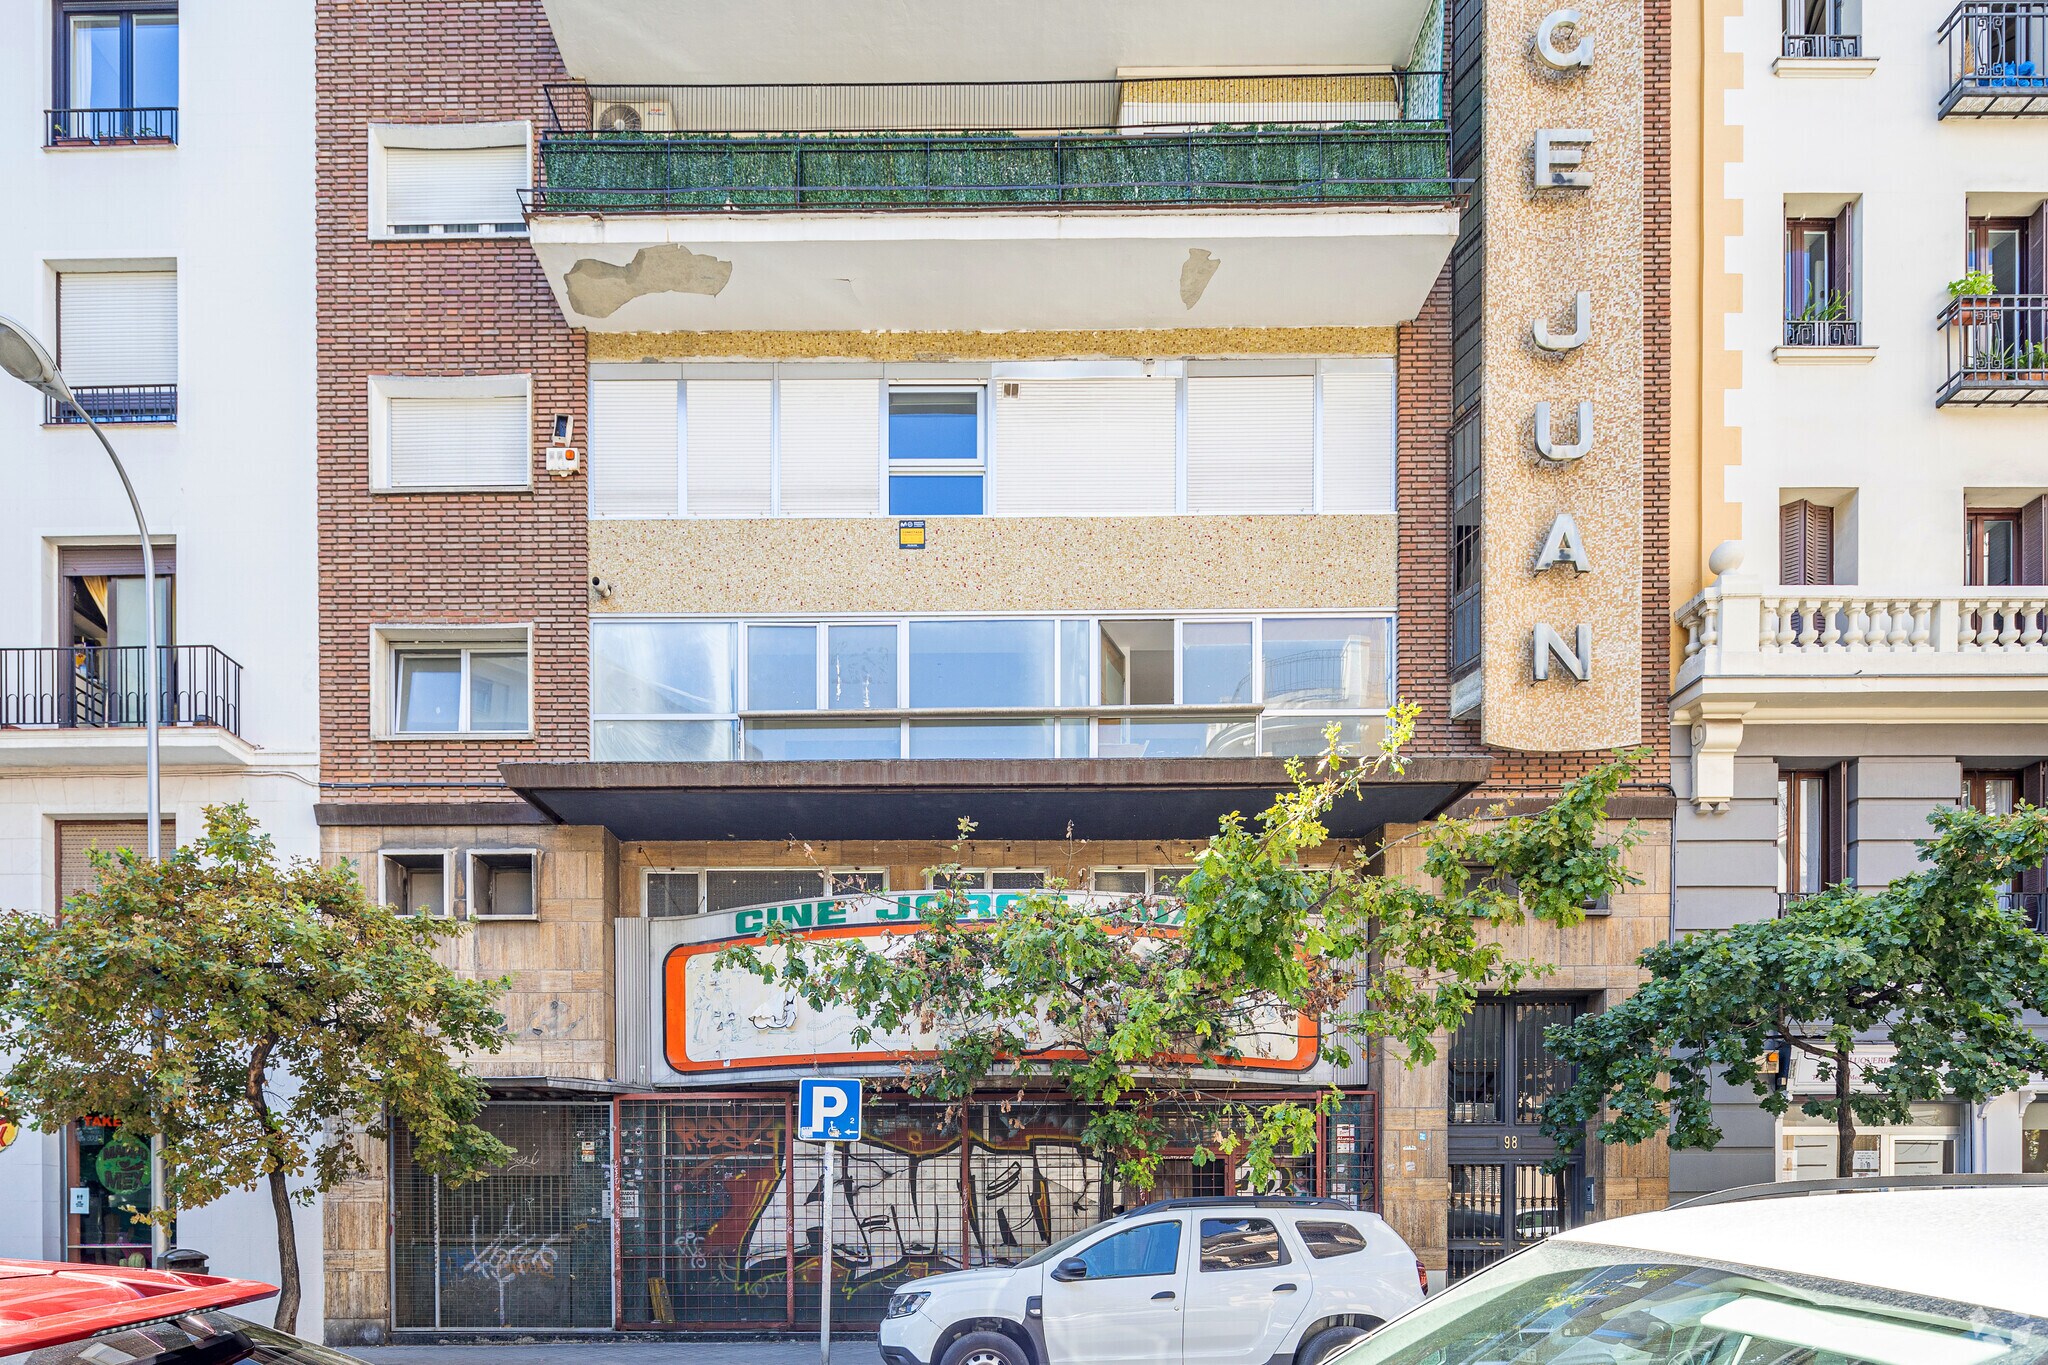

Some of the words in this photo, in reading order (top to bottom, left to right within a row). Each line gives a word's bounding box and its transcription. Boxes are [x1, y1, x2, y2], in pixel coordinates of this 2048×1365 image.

[1531, 290, 1594, 682] JUAN
[735, 901, 847, 934] CINE
[812, 1086, 848, 1132] P
[84, 1116, 122, 1127] TAKE
[849, 1117, 855, 1125] 2
[1504, 1135, 1518, 1150] 98
[104, 1170, 144, 1190] MEX
